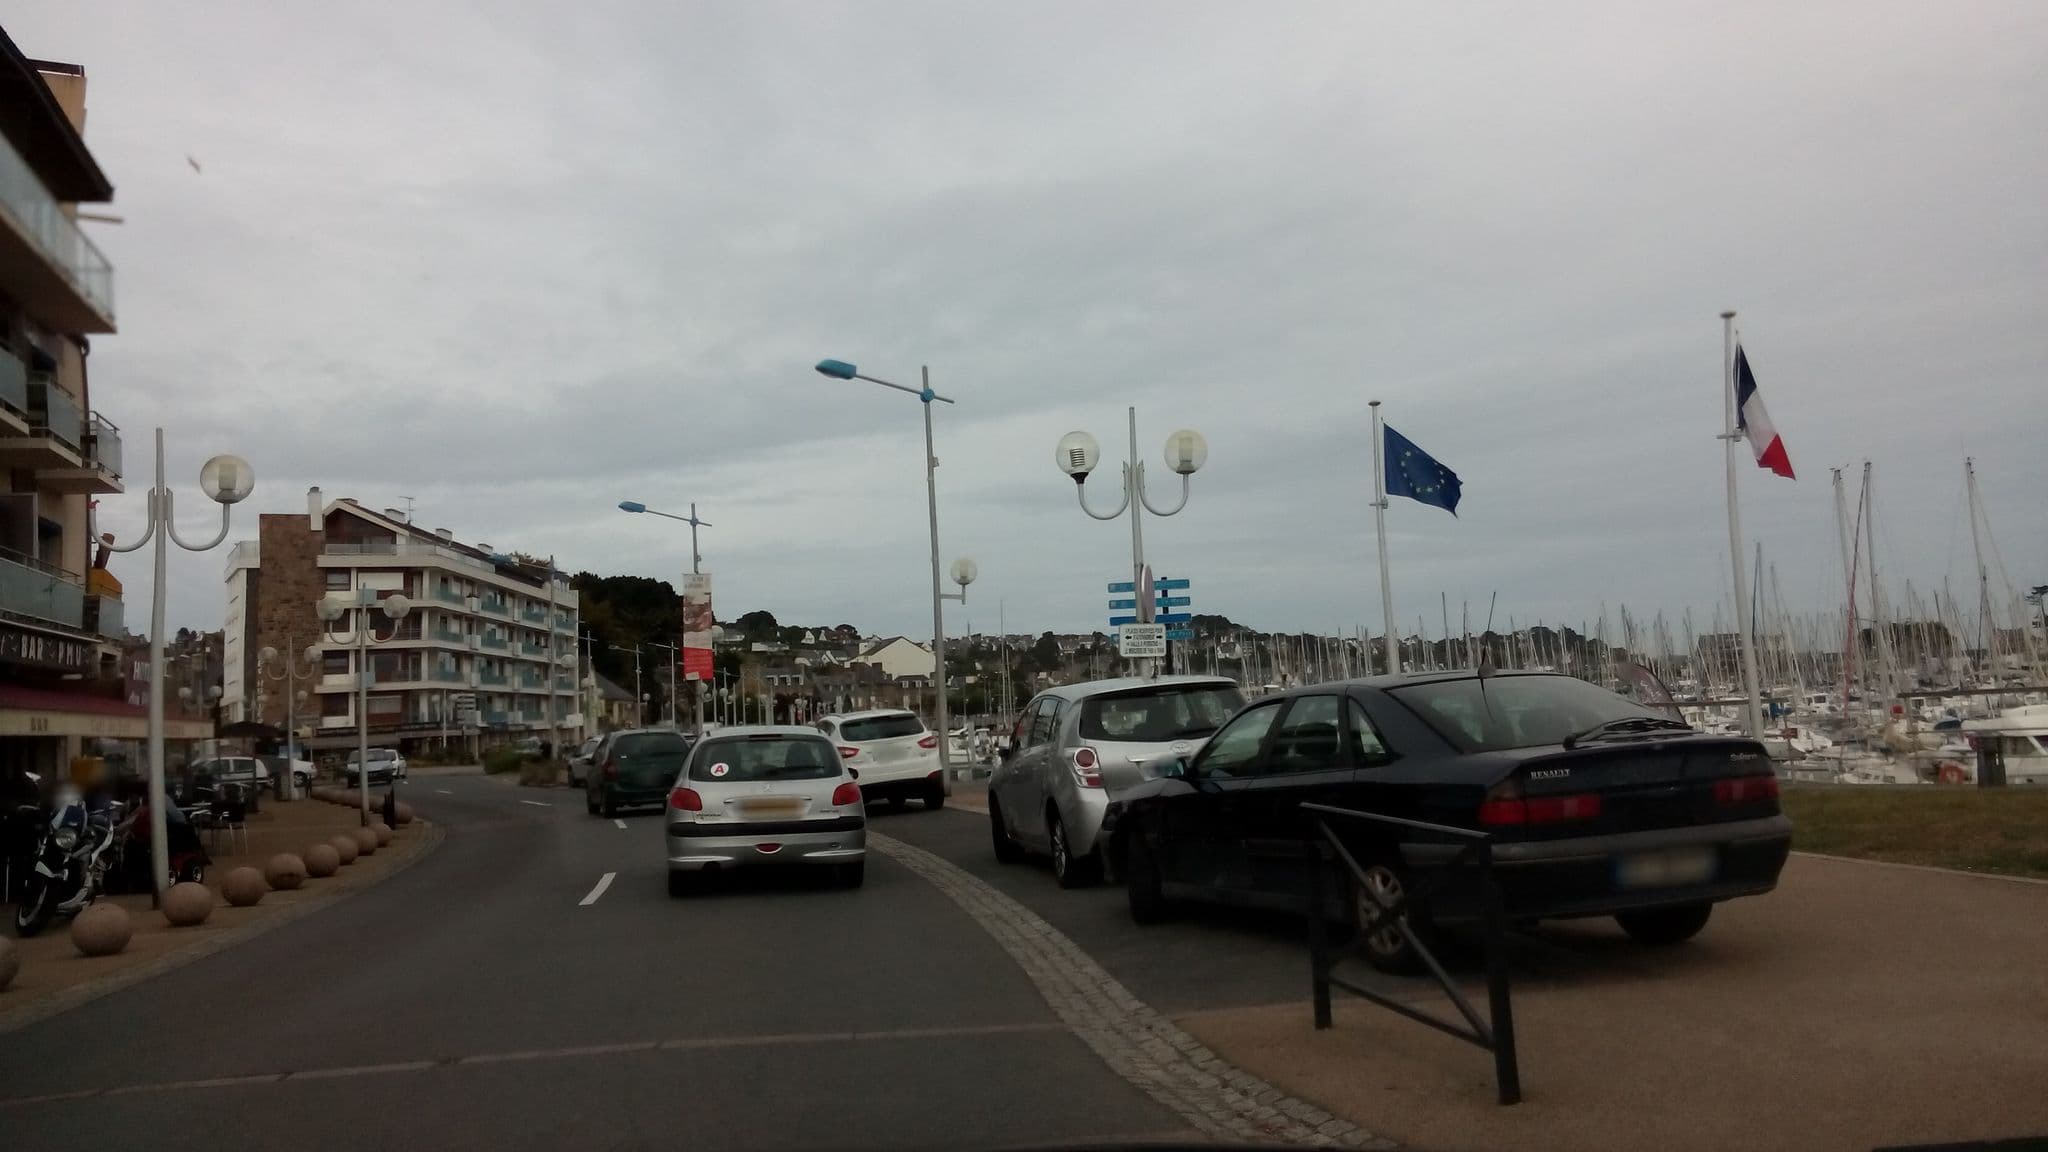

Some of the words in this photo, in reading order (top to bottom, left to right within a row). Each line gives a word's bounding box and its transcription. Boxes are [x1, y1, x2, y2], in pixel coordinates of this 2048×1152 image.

[21, 635, 43, 661] BAR
[714, 764, 725, 774] A
[1529, 768, 1571, 780] RENAULT
